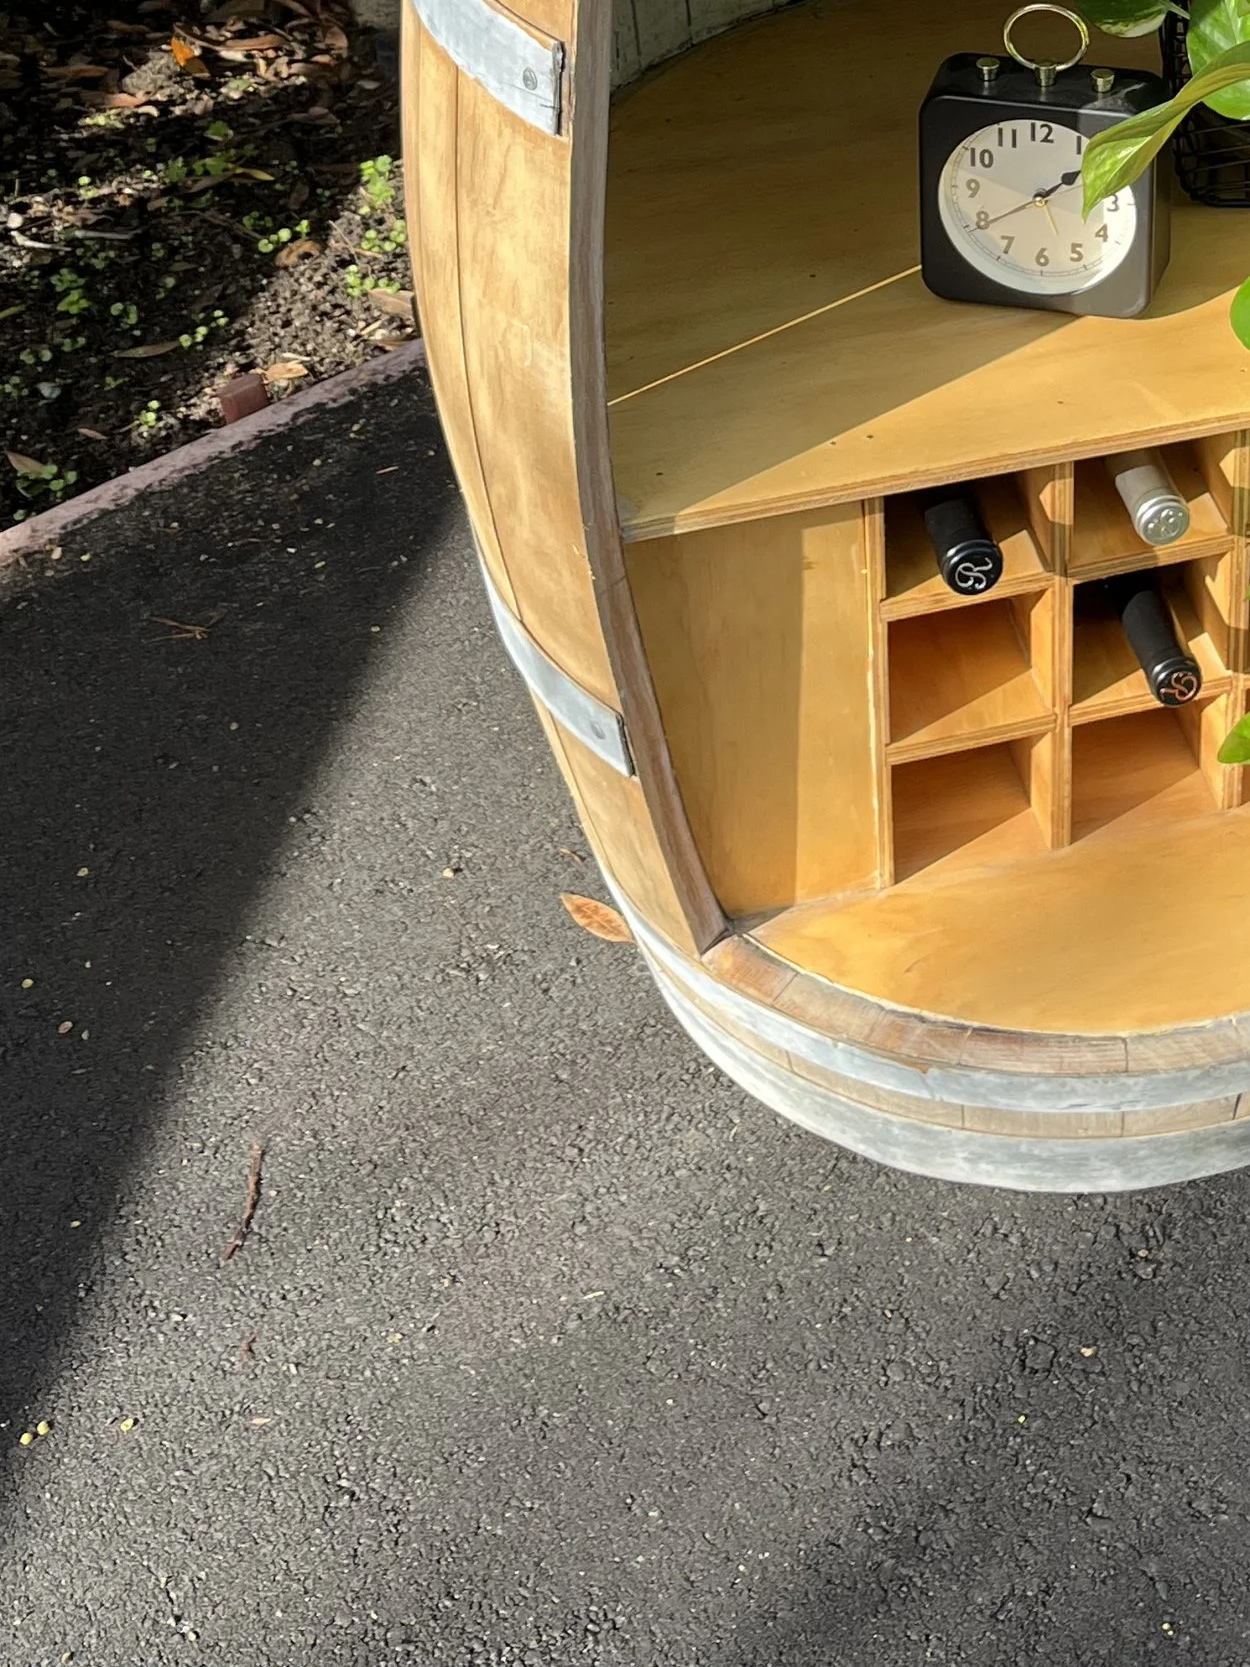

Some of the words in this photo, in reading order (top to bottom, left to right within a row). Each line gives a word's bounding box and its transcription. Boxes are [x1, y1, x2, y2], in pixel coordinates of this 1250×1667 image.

[997, 127, 1017, 149] 11
[1030, 122, 1054, 144] 12
[969, 147, 994, 169] 10
[965, 178, 980, 198] 9
[1106, 194, 1120, 212] 3
[975, 210, 990, 230] 8
[1094, 224, 1109, 243] 4
[1000, 235, 1015, 254] 7
[1069, 243, 1084, 263] 5
[1035, 247, 1050, 267] 6
